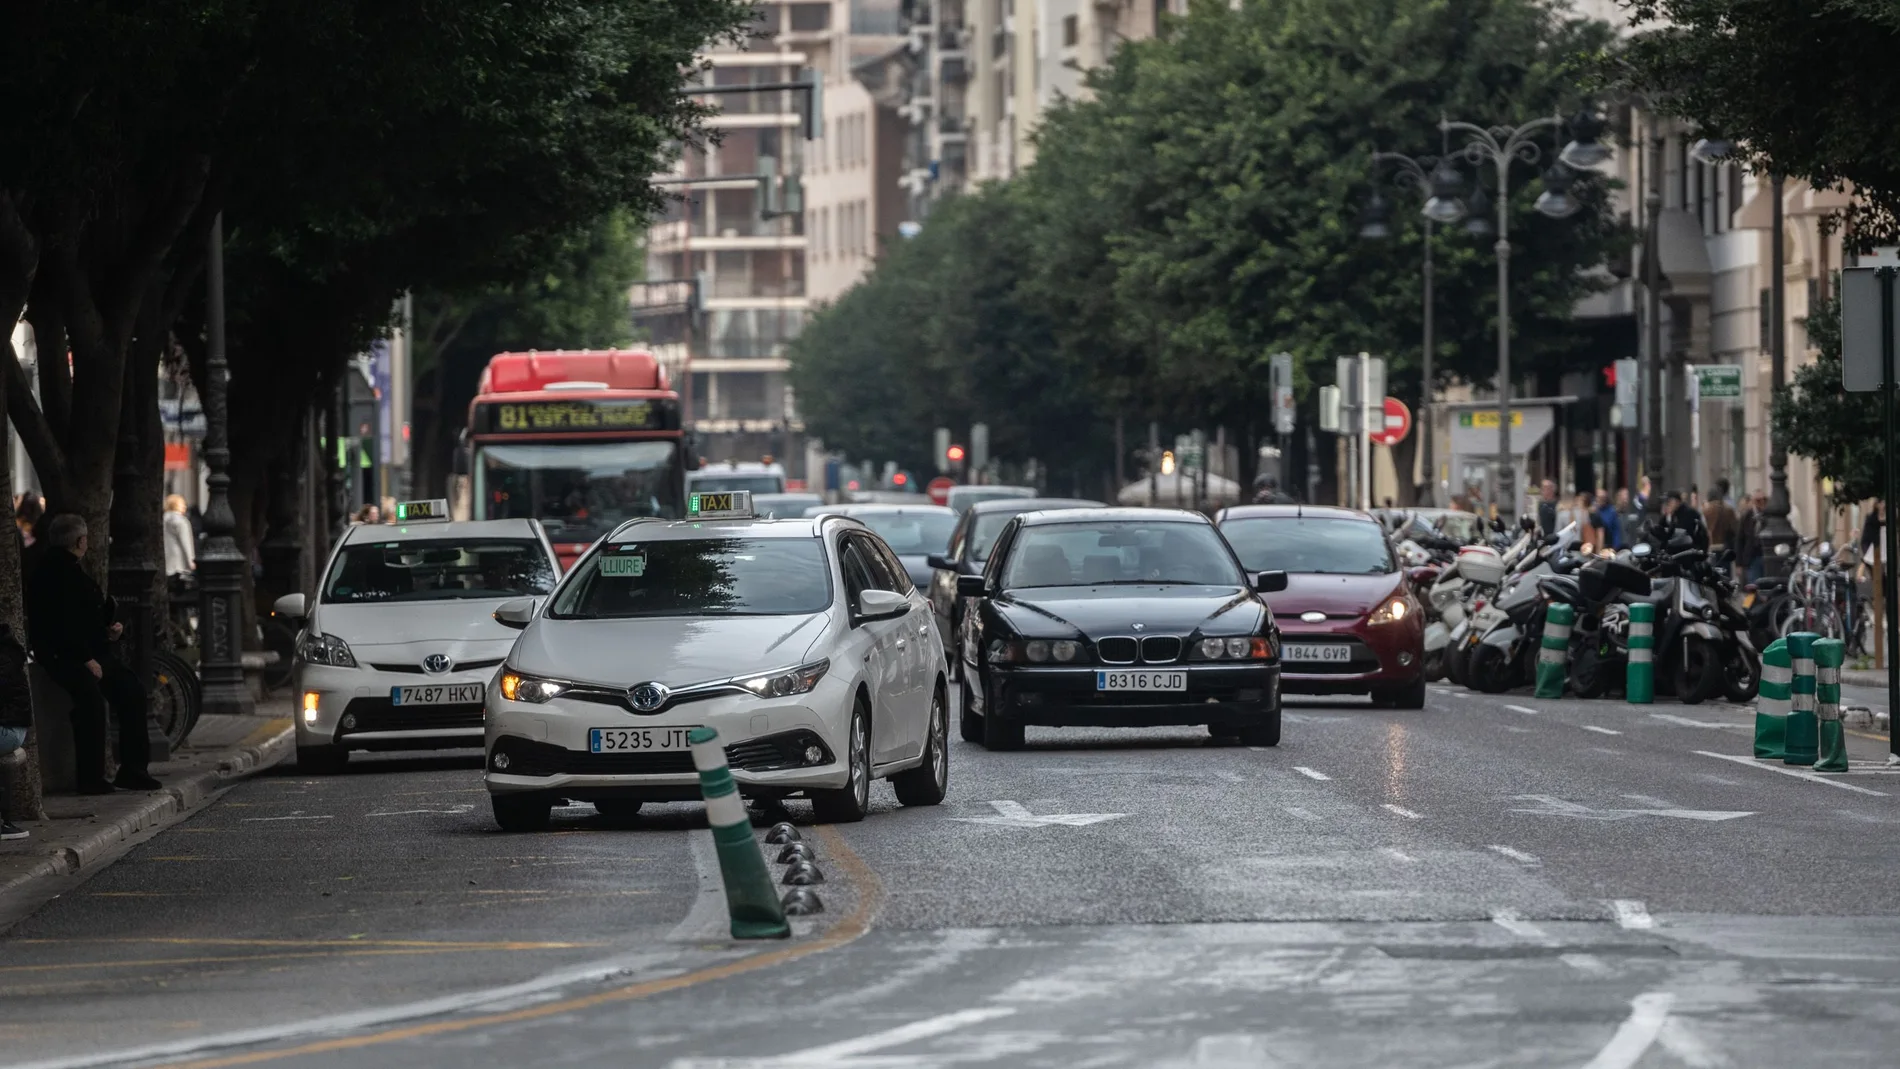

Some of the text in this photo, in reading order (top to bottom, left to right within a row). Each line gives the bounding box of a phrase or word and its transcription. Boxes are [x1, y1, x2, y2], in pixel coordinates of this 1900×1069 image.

[501, 405, 528, 429] 81
[407, 503, 432, 516] TAXI
[700, 495, 731, 511] TAXI
[603, 559, 640, 573] LLIURE
[1288, 647, 1348, 659] 1844 GVR
[1109, 674, 1147, 688] 8316
[1153, 674, 1182, 688] CJD
[403, 686, 478, 703] 7487 HKV
[606, 731, 652, 749] 5235
